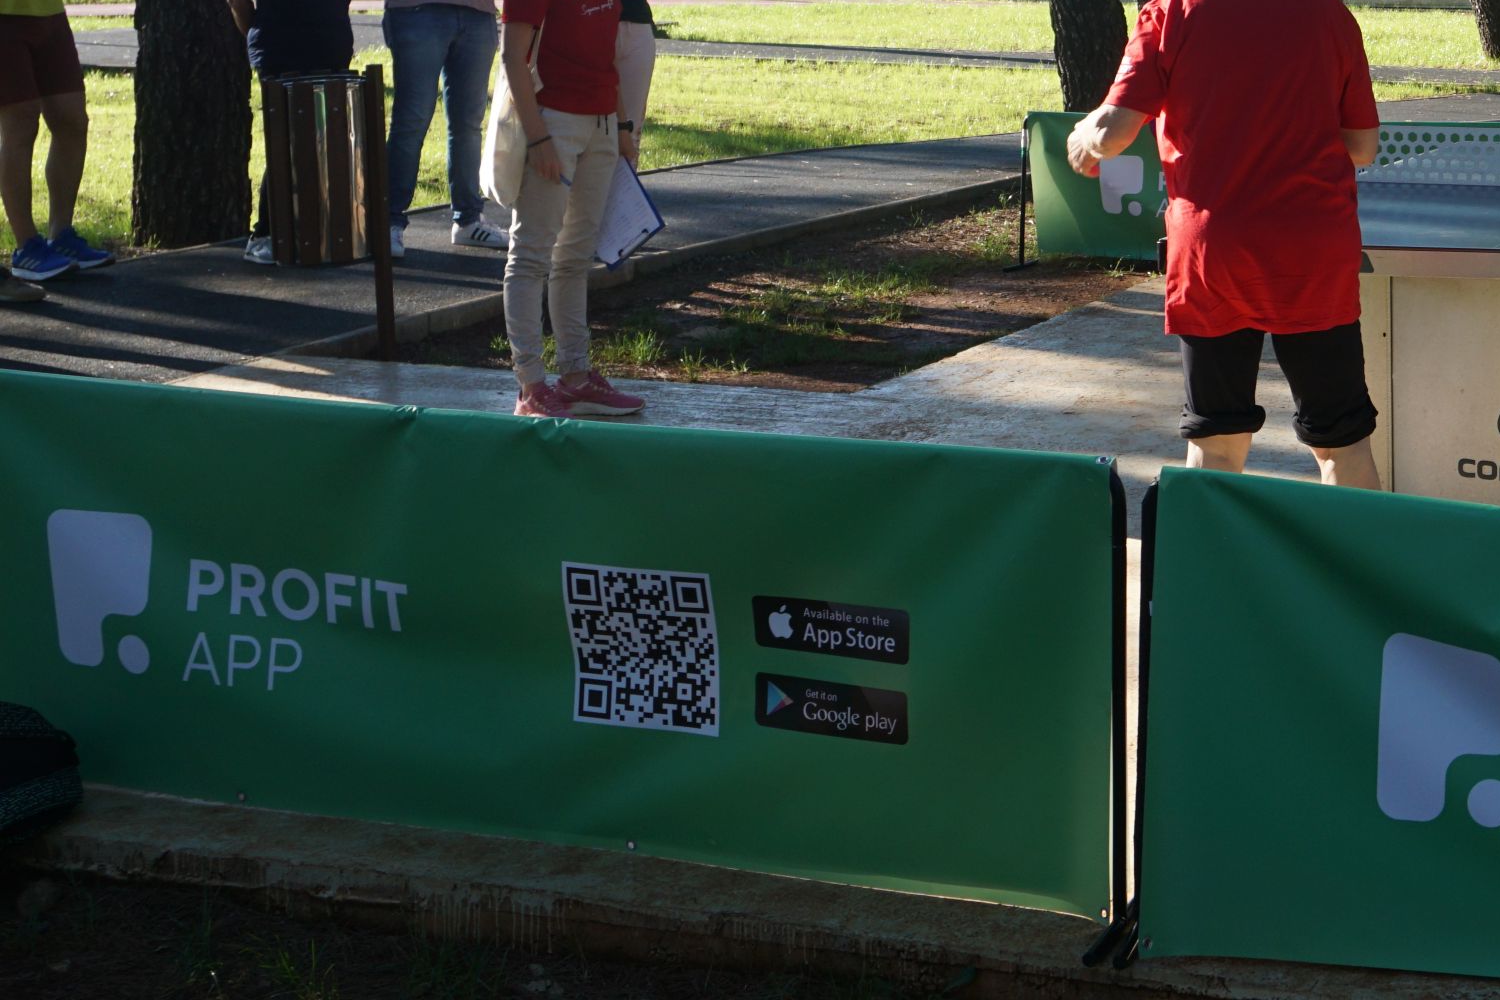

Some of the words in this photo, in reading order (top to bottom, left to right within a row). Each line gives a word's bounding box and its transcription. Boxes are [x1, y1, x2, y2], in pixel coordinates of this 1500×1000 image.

[186, 558, 408, 633] PROFIT
[803, 607, 851, 623] Available
[855, 613, 869, 625] on
[872, 615, 890, 627] the
[803, 622, 842, 650] App
[846, 627, 896, 653] Store
[182, 631, 303, 691] APP
[805, 688, 819, 700] Get
[820, 690, 826, 700] it
[827, 693, 838, 702] on
[802, 701, 861, 731] Google
[865, 712, 897, 735] play
